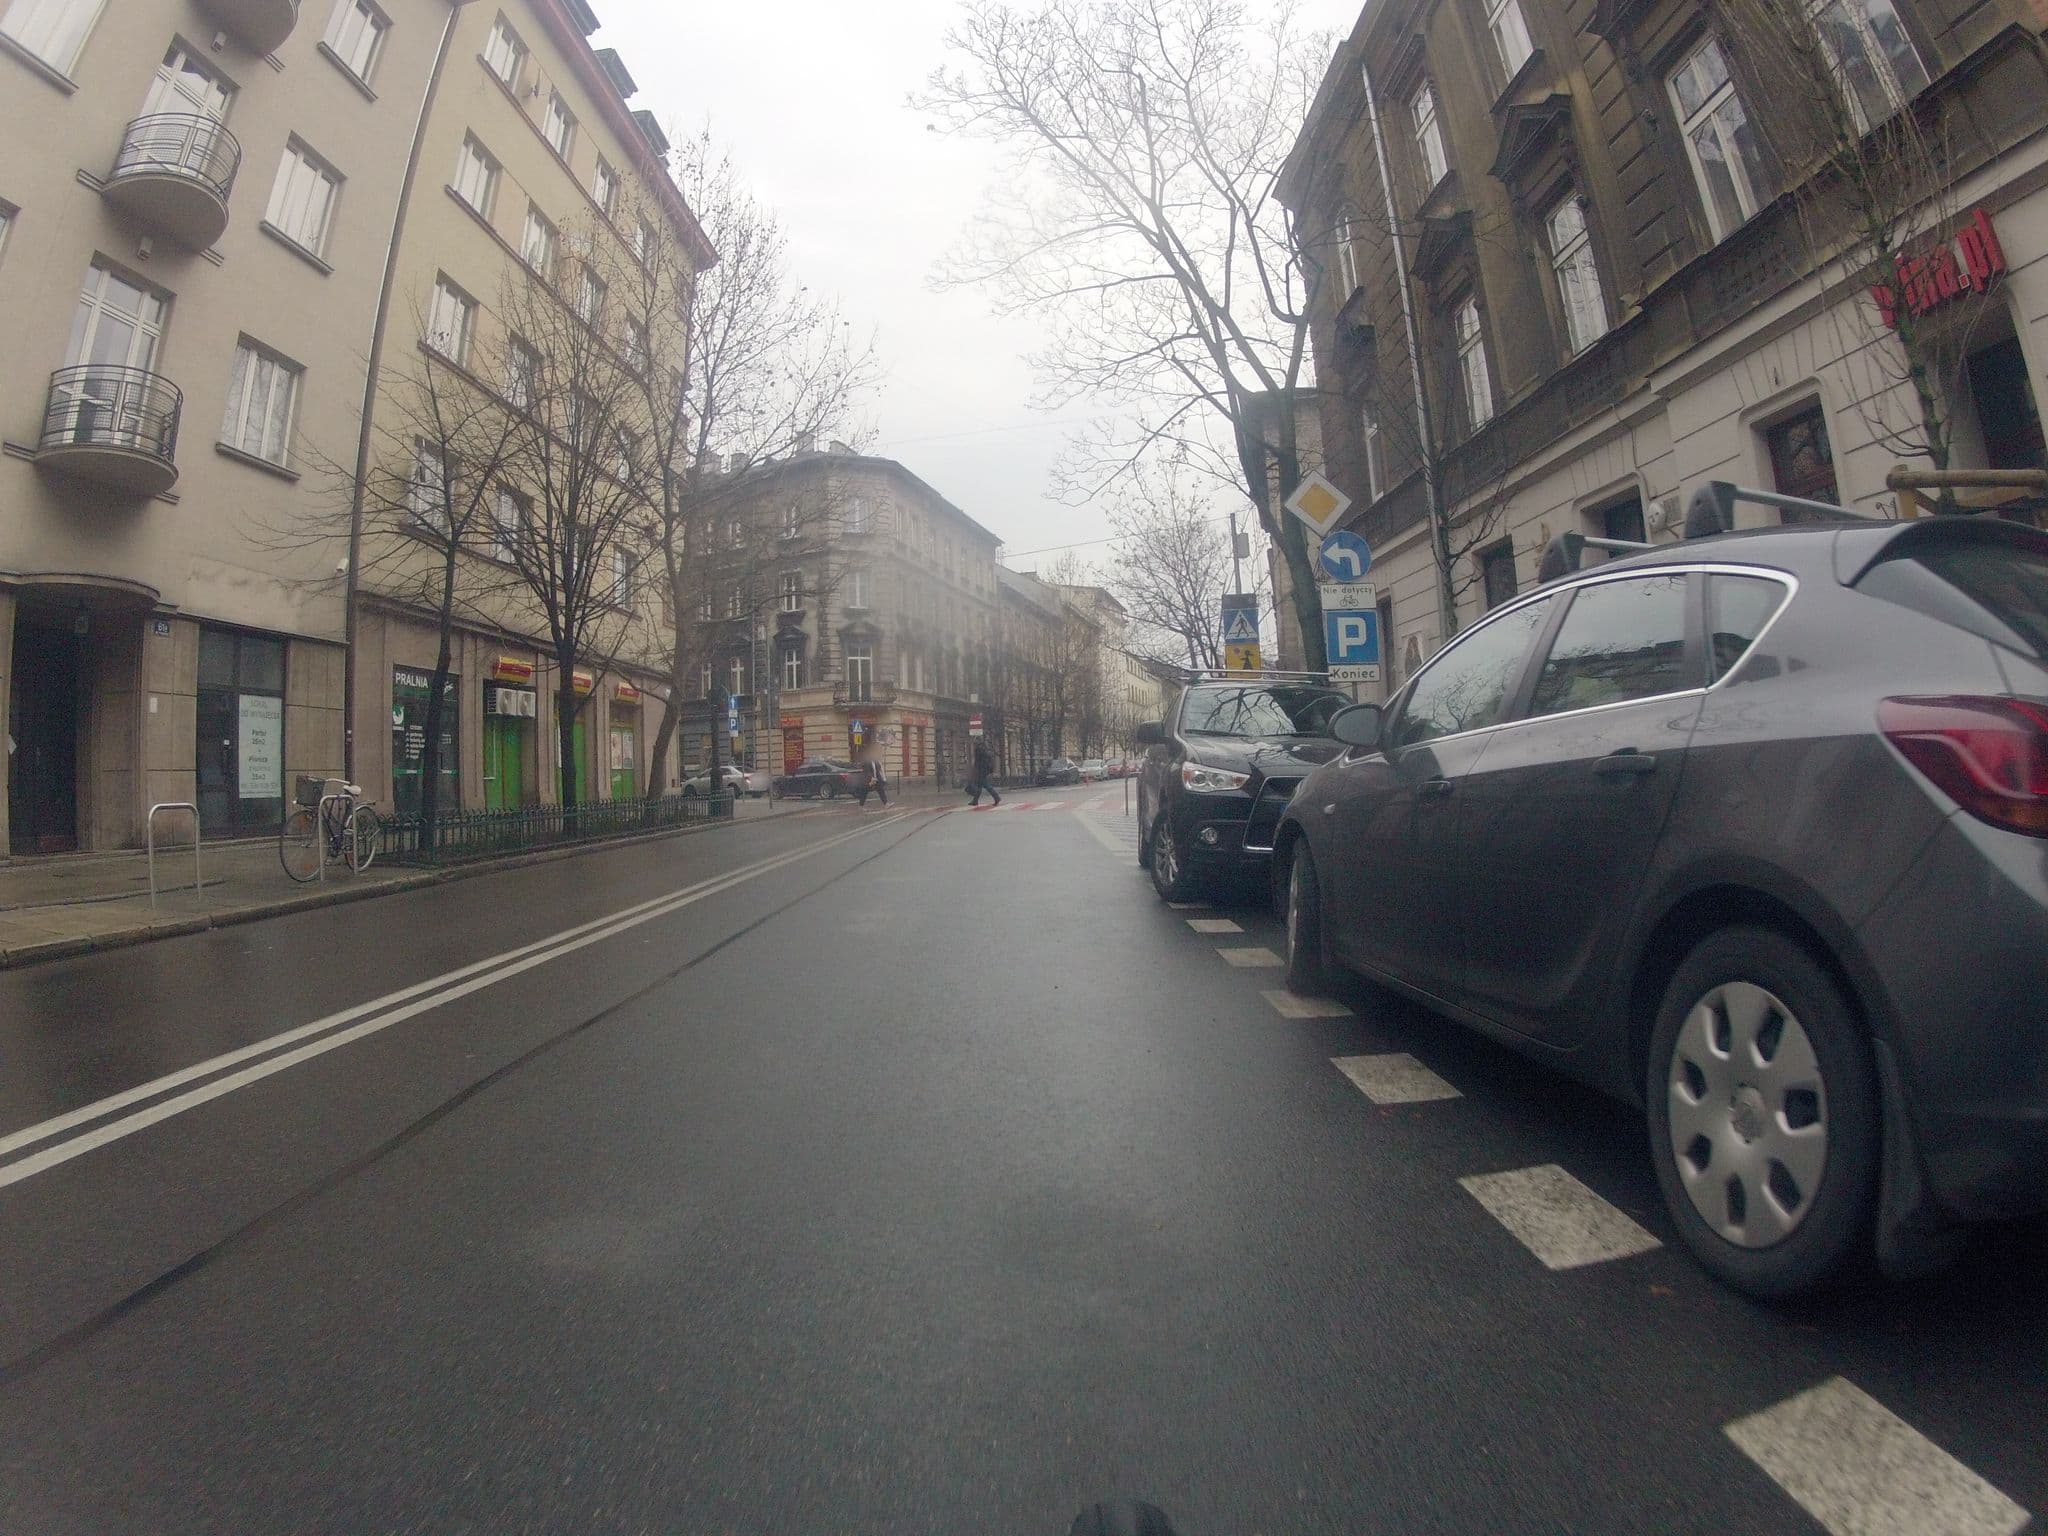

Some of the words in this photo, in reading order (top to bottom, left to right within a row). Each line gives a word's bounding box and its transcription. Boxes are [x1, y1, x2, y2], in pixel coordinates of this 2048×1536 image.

[1323, 586, 1338, 594] Nie
[1341, 586, 1373, 595] dotyczy
[1337, 616, 1367, 658] P
[1332, 667, 1376, 679] Koniec
[395, 672, 429, 689] PRALNIA
